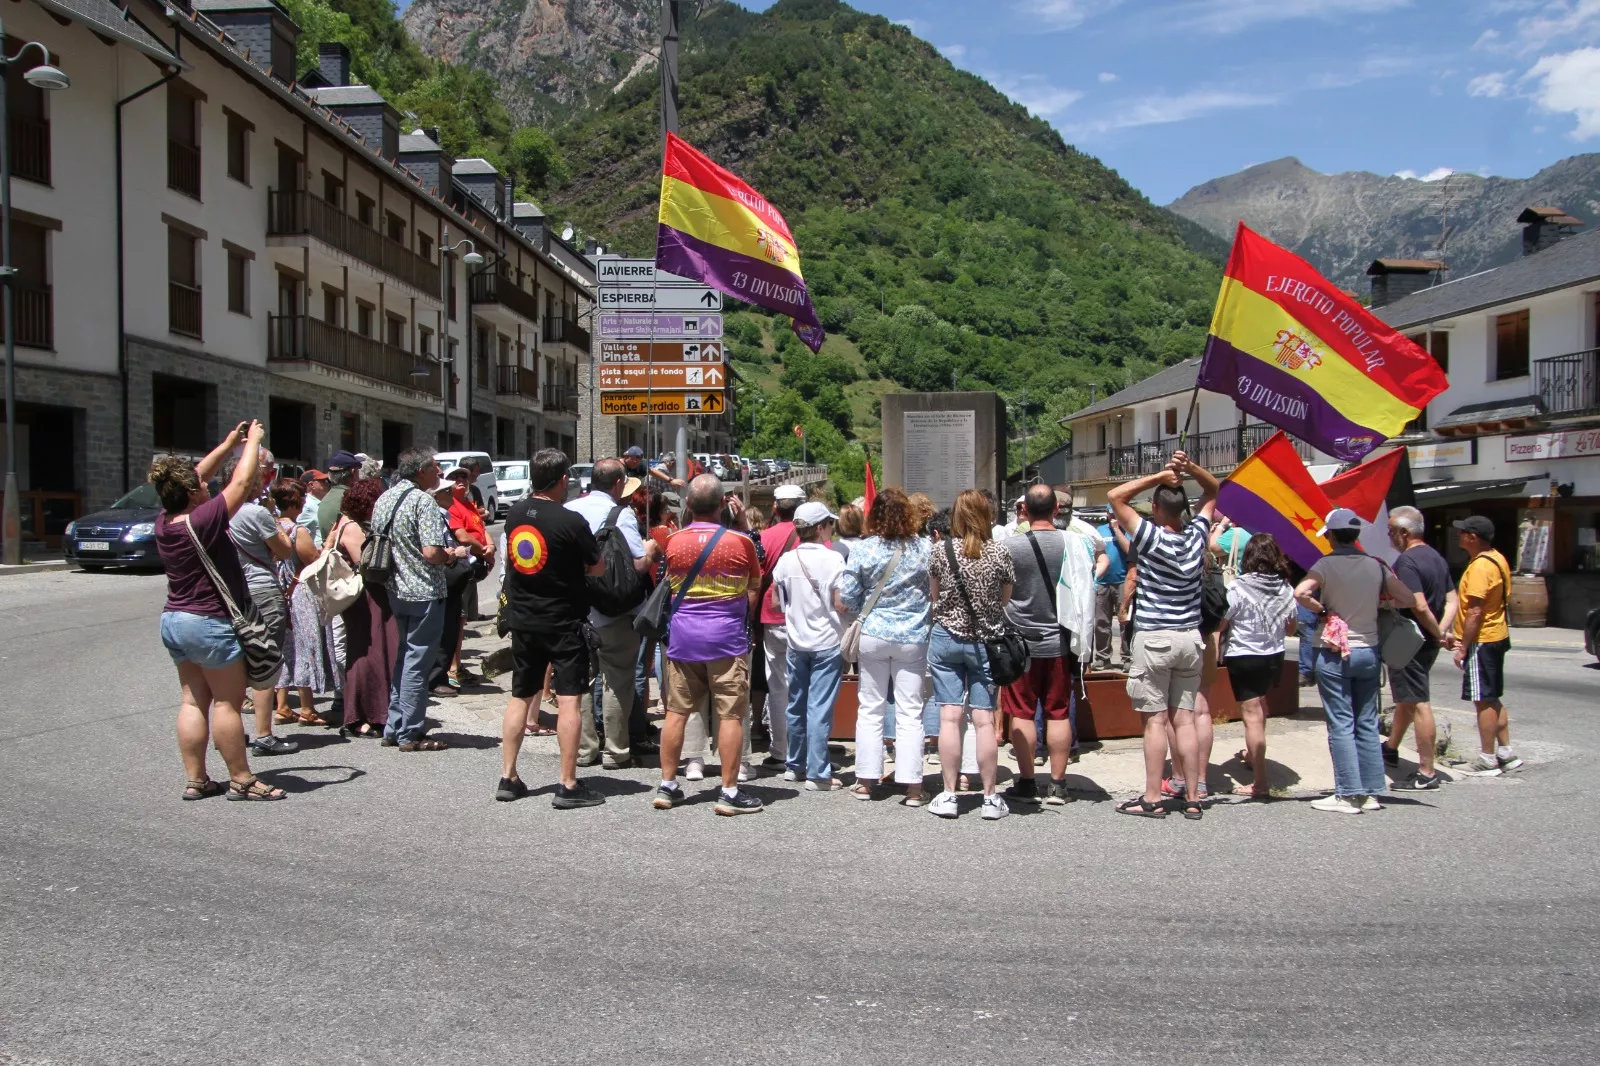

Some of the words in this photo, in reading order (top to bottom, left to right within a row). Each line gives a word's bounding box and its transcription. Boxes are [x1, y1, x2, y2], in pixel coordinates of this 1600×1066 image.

[601, 266, 654, 276] JAVIERRE
[749, 277, 806, 306] DIVISIÓN
[601, 293, 657, 303] ESPIERBA
[602, 317, 617, 325] Arte
[623, 317, 659, 325] Naturalea
[1265, 275, 1335, 315] EJERCITO
[1331, 309, 1385, 373] POPULAR
[602, 343, 625, 351] Valle
[626, 343, 638, 351] de
[602, 351, 641, 362] Pineta
[601, 368, 622, 376] pista
[648, 367, 658, 375] de
[660, 367, 684, 375] fondo
[614, 377, 629, 385] Km
[604, 394, 637, 403] parador
[1249, 383, 1309, 420] DIVISIÓN
[604, 402, 638, 412] Monte
[640, 400, 680, 411] Perdido
